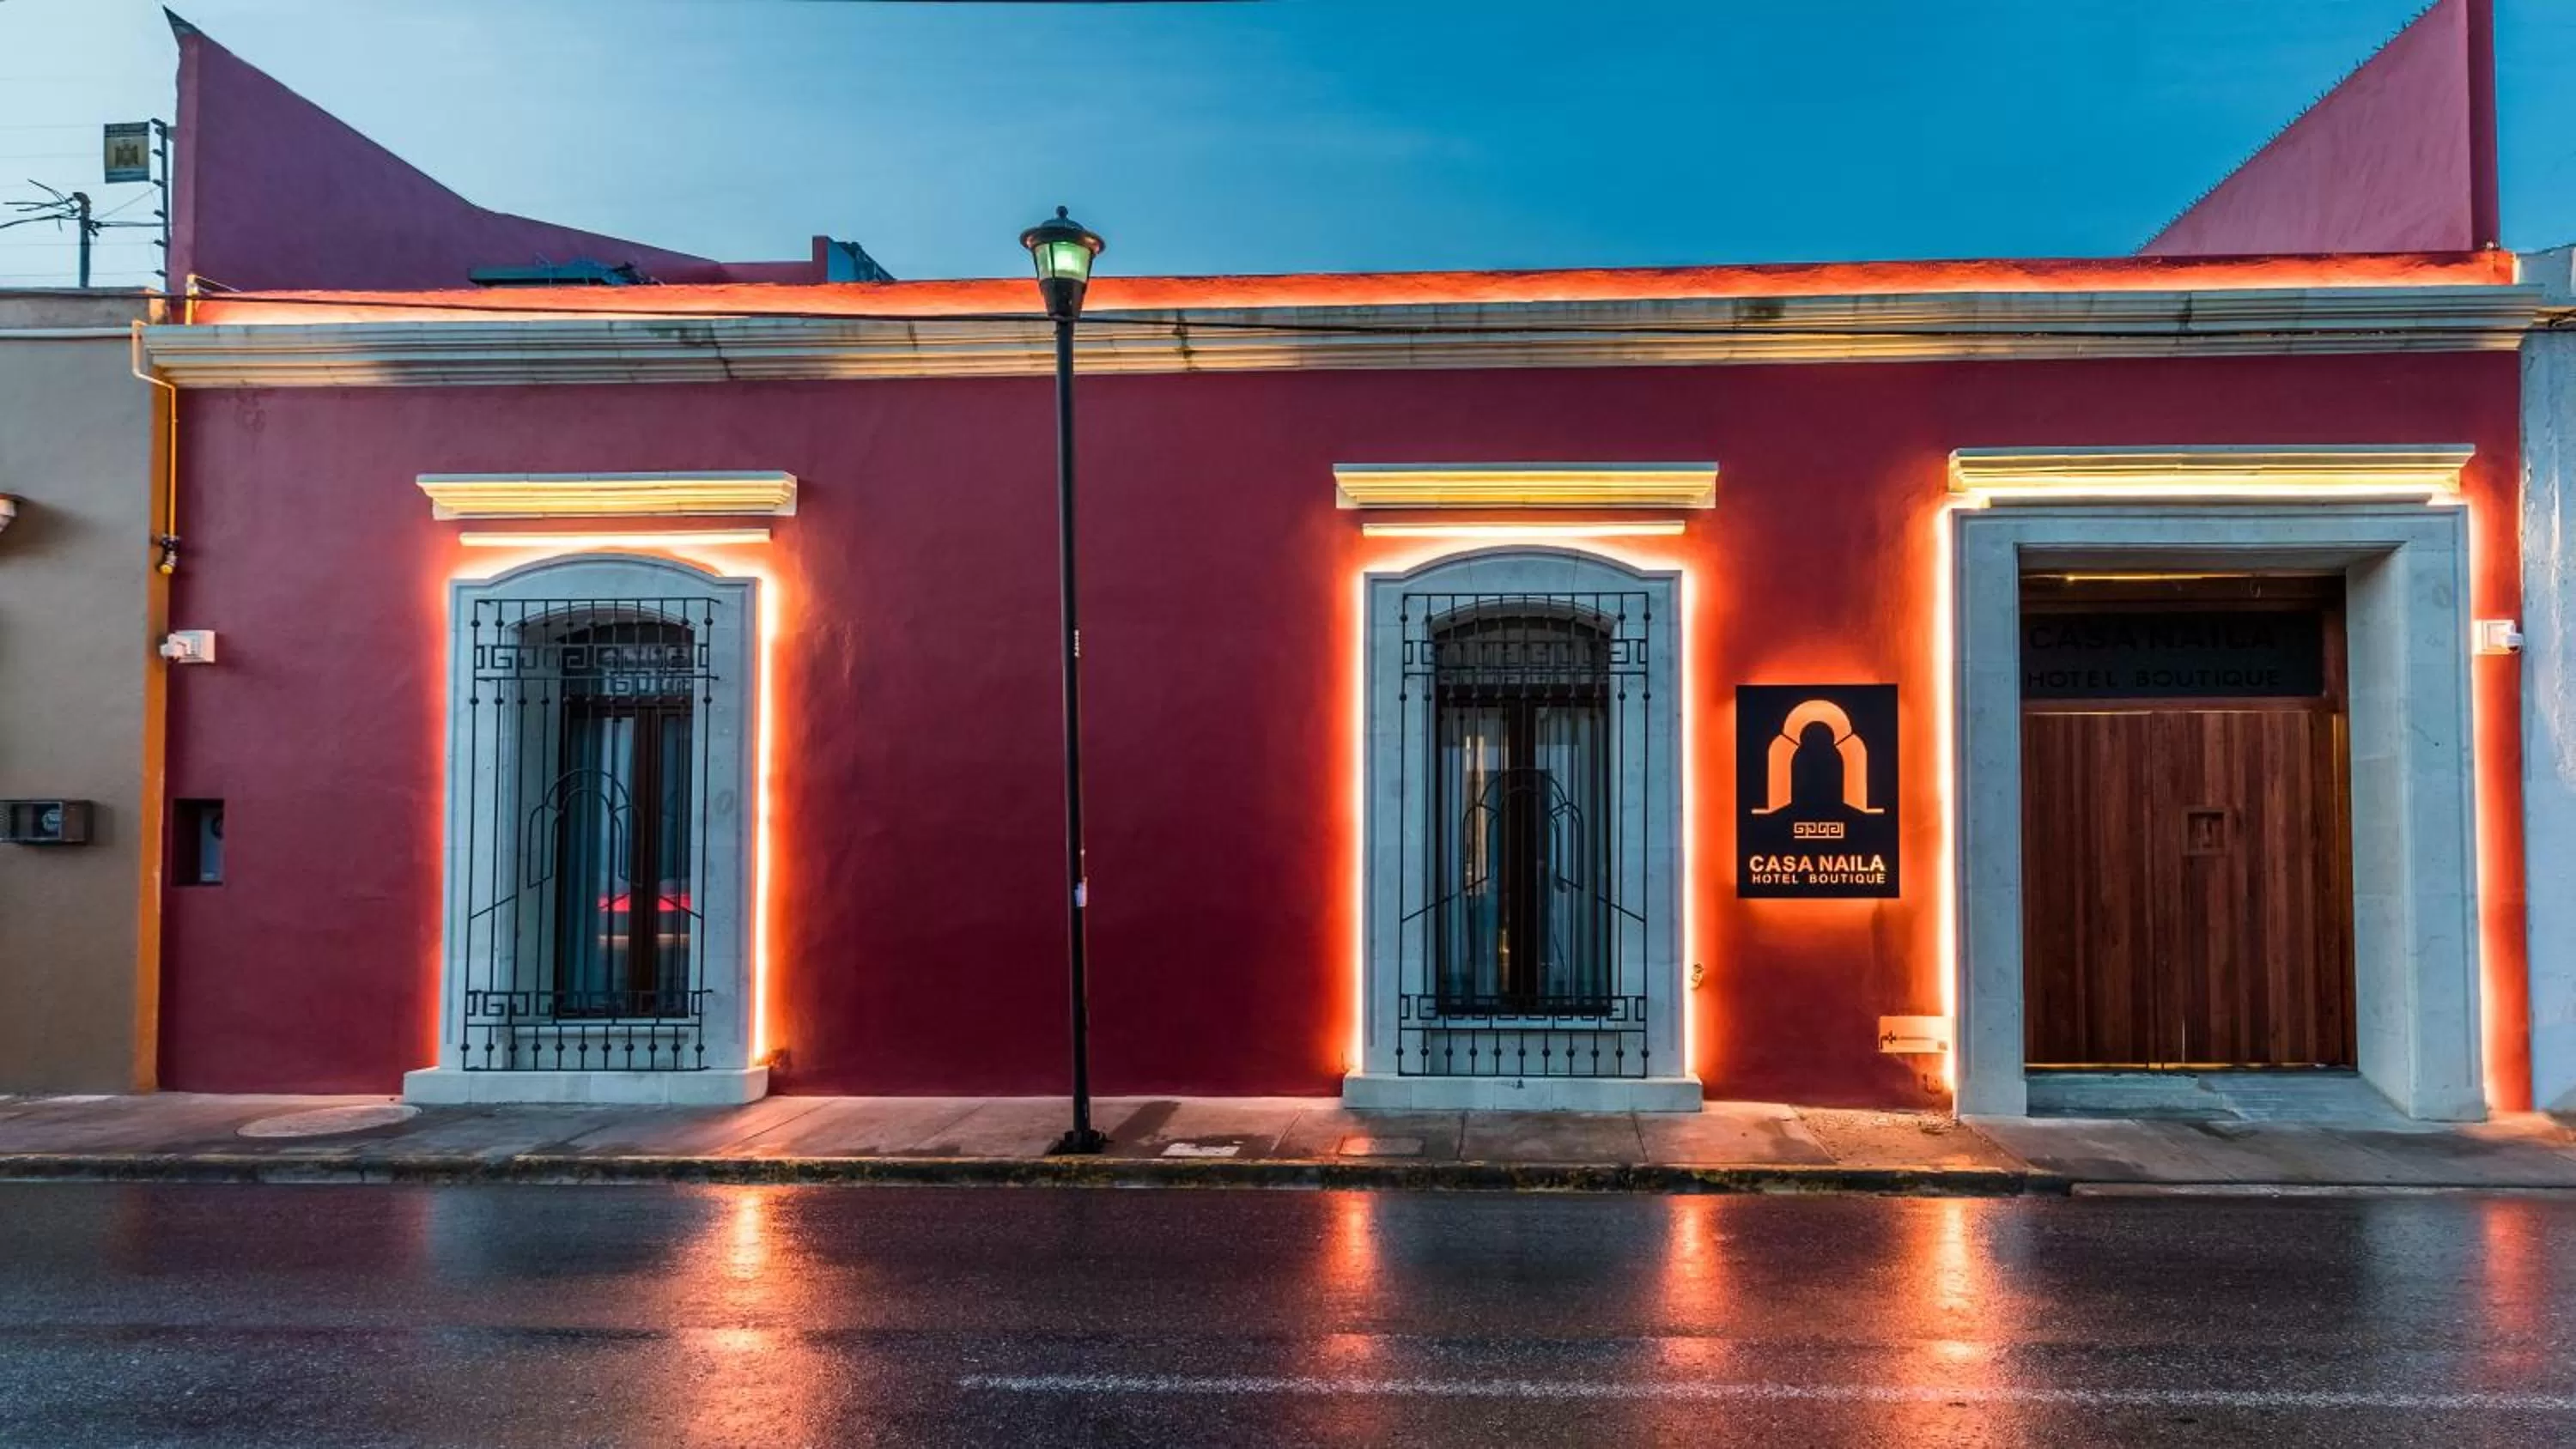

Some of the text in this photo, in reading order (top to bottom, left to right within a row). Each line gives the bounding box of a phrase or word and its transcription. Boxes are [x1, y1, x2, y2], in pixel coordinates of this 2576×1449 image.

[2027, 668, 2281, 688] HOTEL BOUTIQUE
[1749, 855, 1885, 872] CASA NAILA
[1753, 874, 1886, 884] HOTEL BOUTIQUE
